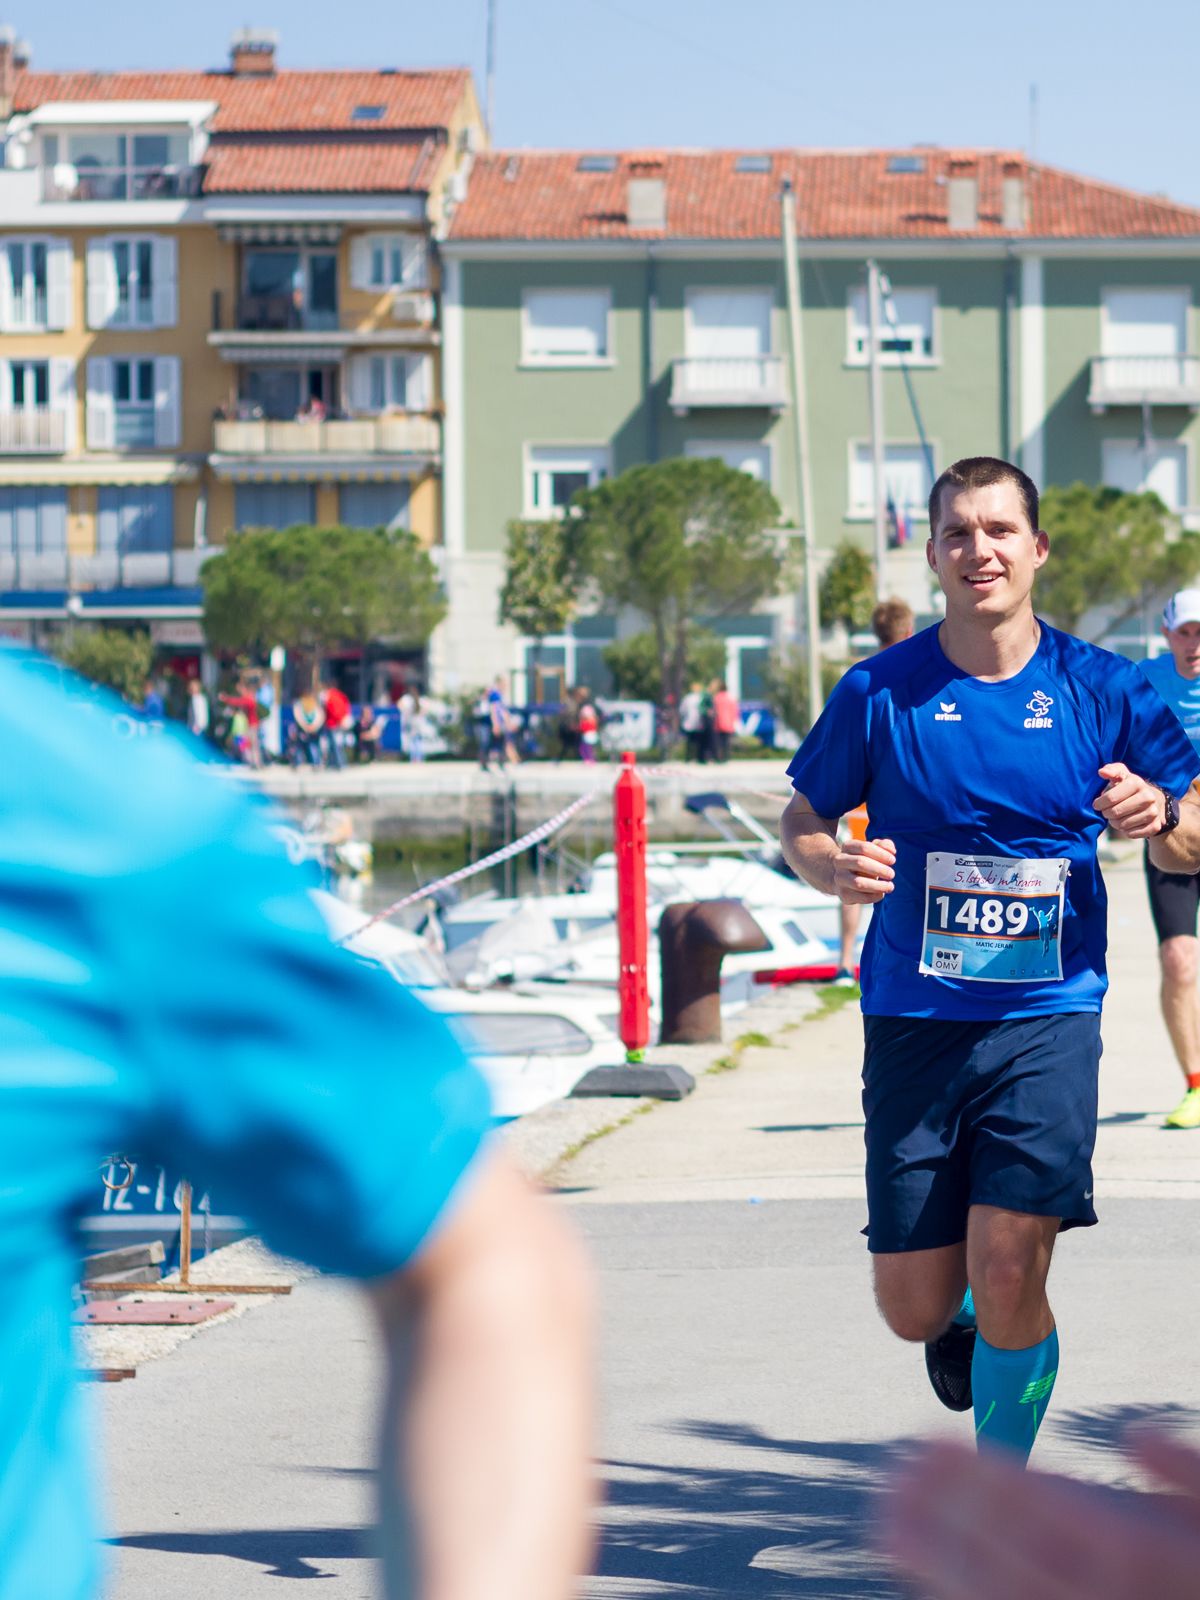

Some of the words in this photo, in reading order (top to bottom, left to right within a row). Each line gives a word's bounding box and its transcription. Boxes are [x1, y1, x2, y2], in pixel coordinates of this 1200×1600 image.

[935, 713, 962, 721] erima
[936, 895, 1029, 936] 1489
[935, 961, 958, 970] OMV
